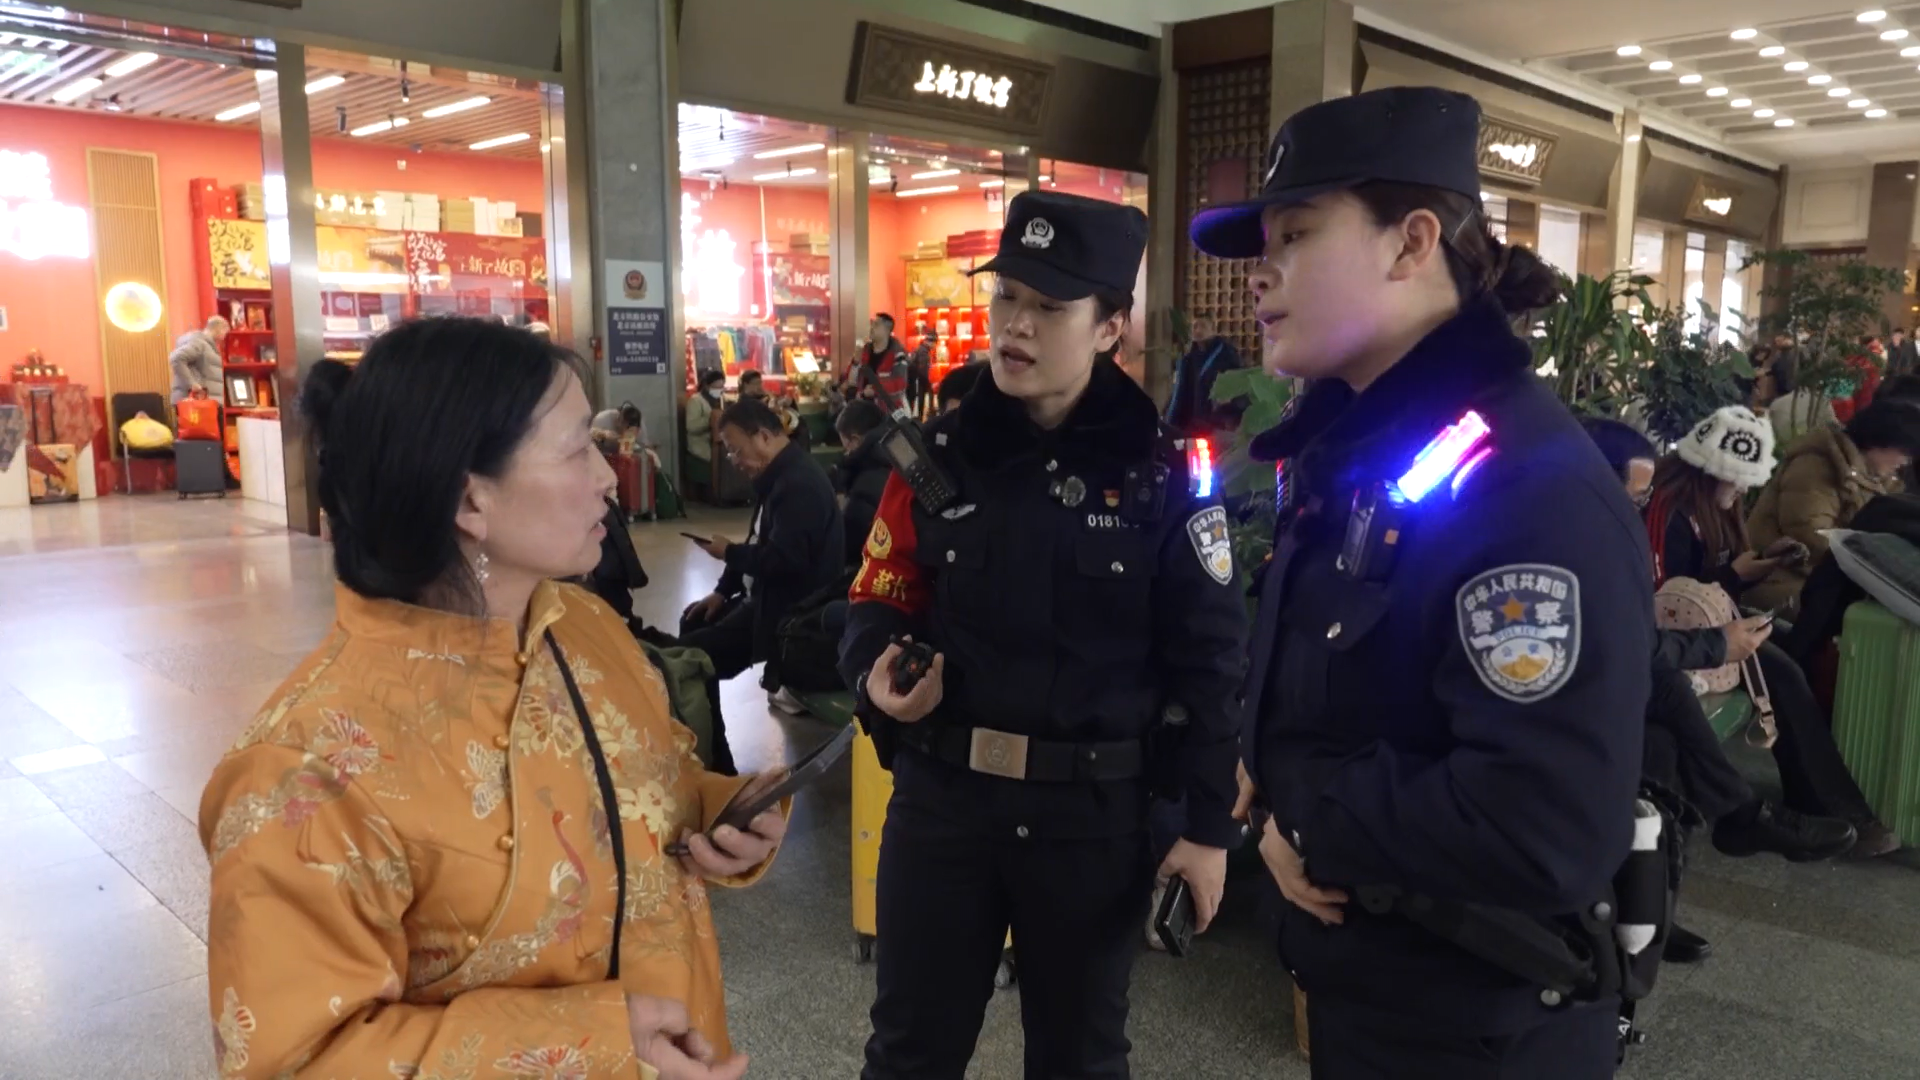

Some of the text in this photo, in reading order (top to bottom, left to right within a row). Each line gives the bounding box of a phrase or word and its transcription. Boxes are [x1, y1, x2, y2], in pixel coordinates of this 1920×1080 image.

[1463, 573, 1568, 612] 中华人民共和国
